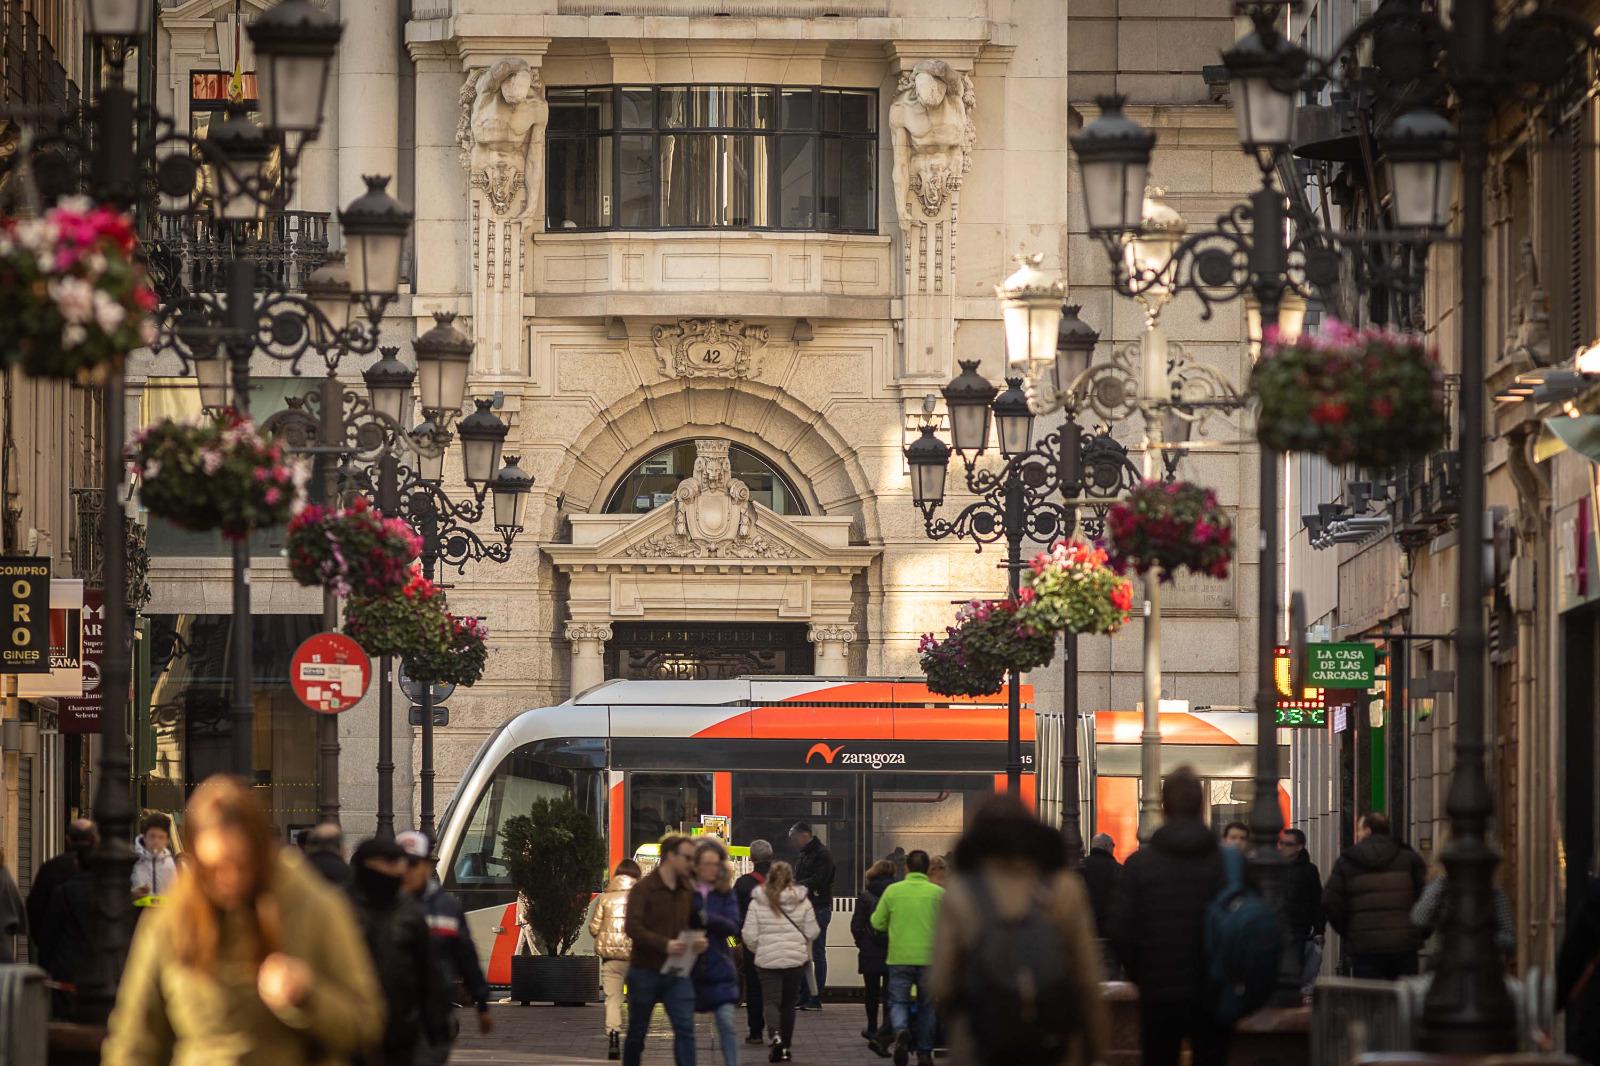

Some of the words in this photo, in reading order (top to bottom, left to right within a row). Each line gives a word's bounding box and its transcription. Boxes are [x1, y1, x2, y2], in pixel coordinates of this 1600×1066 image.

[703, 350, 720, 363] 42
[0, 566, 48, 576] COMPRO
[12, 580, 31, 646] ORO
[83, 624, 102, 636] AR
[3, 650, 40, 660] GINES
[1317, 650, 1333, 659] LA
[1336, 650, 1364, 659] CASA
[1320, 661, 1336, 670] DE
[1340, 661, 1360, 670] LAS
[1312, 671, 1369, 680] CARCASAS
[842, 753, 906, 769] zaragoza
[1020, 755, 1033, 764] 15
